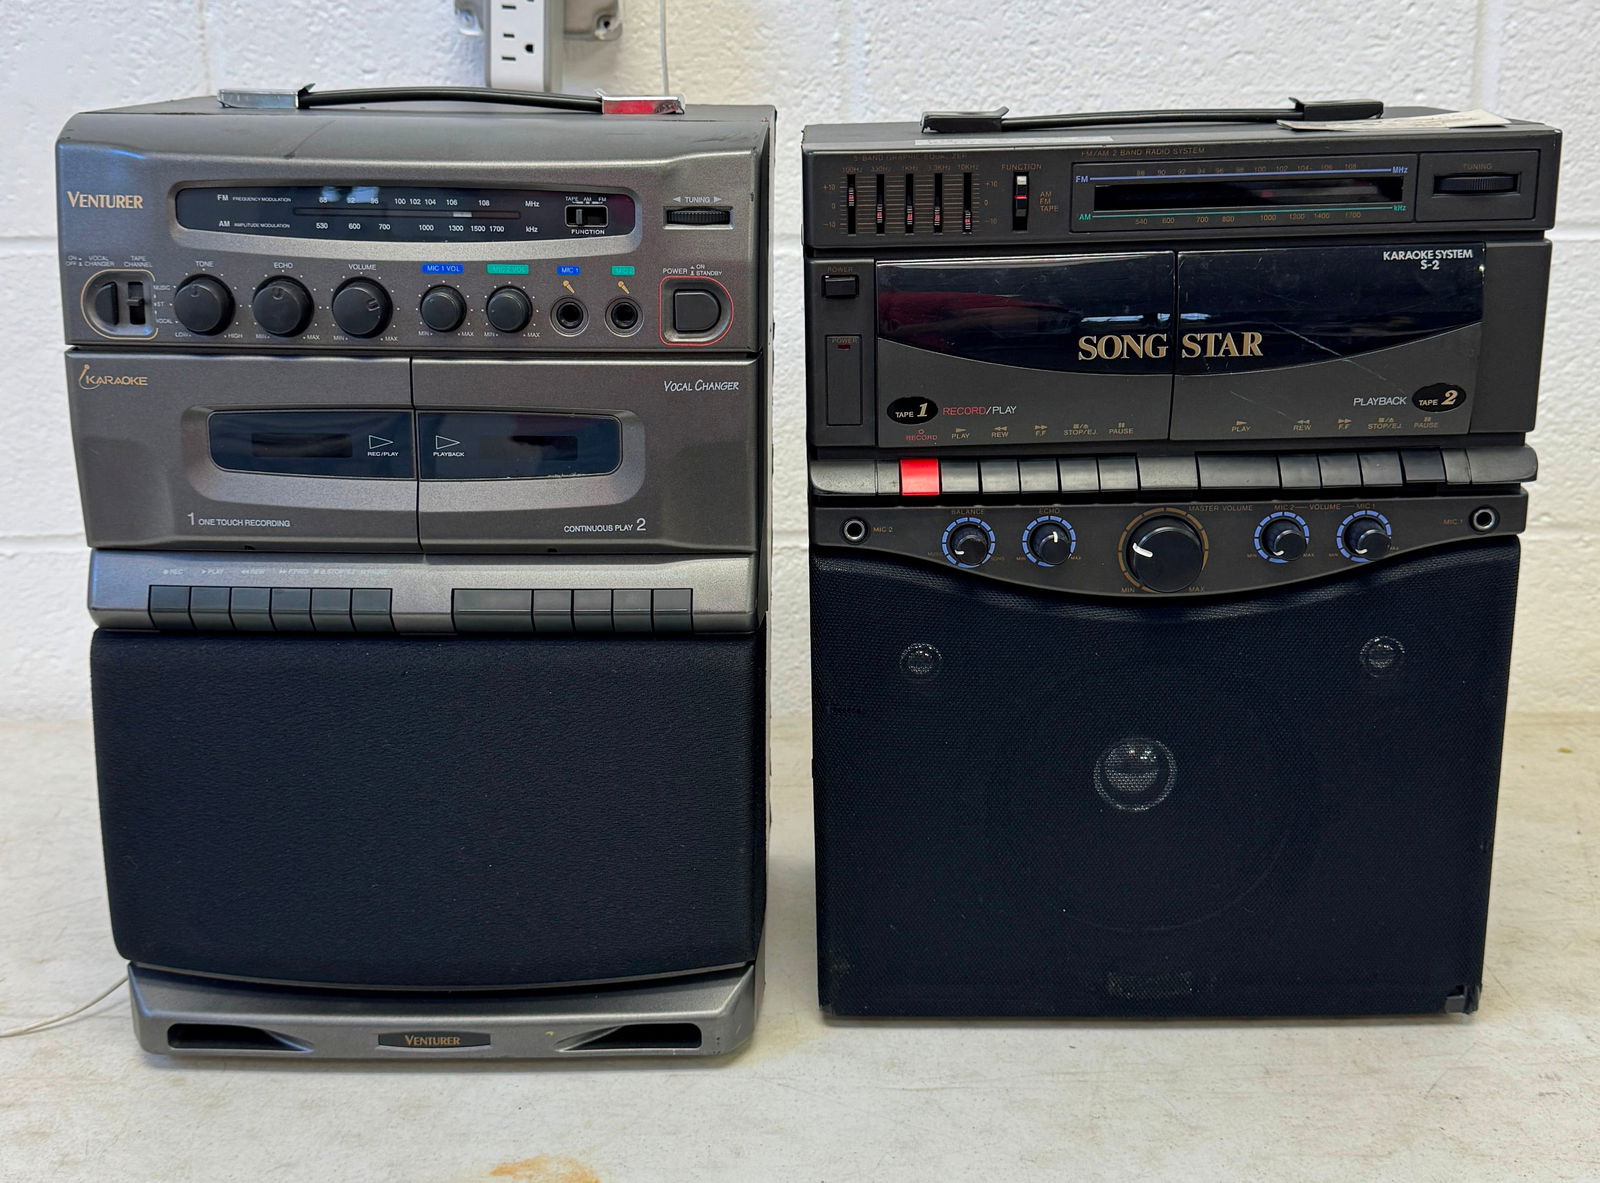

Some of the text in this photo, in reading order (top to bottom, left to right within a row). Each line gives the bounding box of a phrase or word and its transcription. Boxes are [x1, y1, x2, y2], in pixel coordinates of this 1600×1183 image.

[1146, 148, 1170, 156] RADIO
[1392, 166, 1408, 174] MHz
[67, 191, 144, 210] VENTURER
[316, 222, 328, 230] 530
[1383, 250, 1473, 261] KARAOKE SYSTEM
[1421, 260, 1440, 270] S-2
[1078, 332, 1263, 361] SONG STAR
[664, 379, 739, 392] VOCAL CHANGER
[1353, 396, 1408, 407] PLAYBACK
[1440, 390, 1458, 405] 2
[917, 402, 928, 417] 1
[943, 406, 1017, 416] RECORD/PLAY
[187, 512, 194, 526] 1
[198, 518, 215, 526] ONE
[245, 519, 291, 527] RECORDING
[563, 524, 613, 533] CONTINUOUS
[636, 517, 646, 531] 2
[405, 1034, 461, 1046] VENTURER
